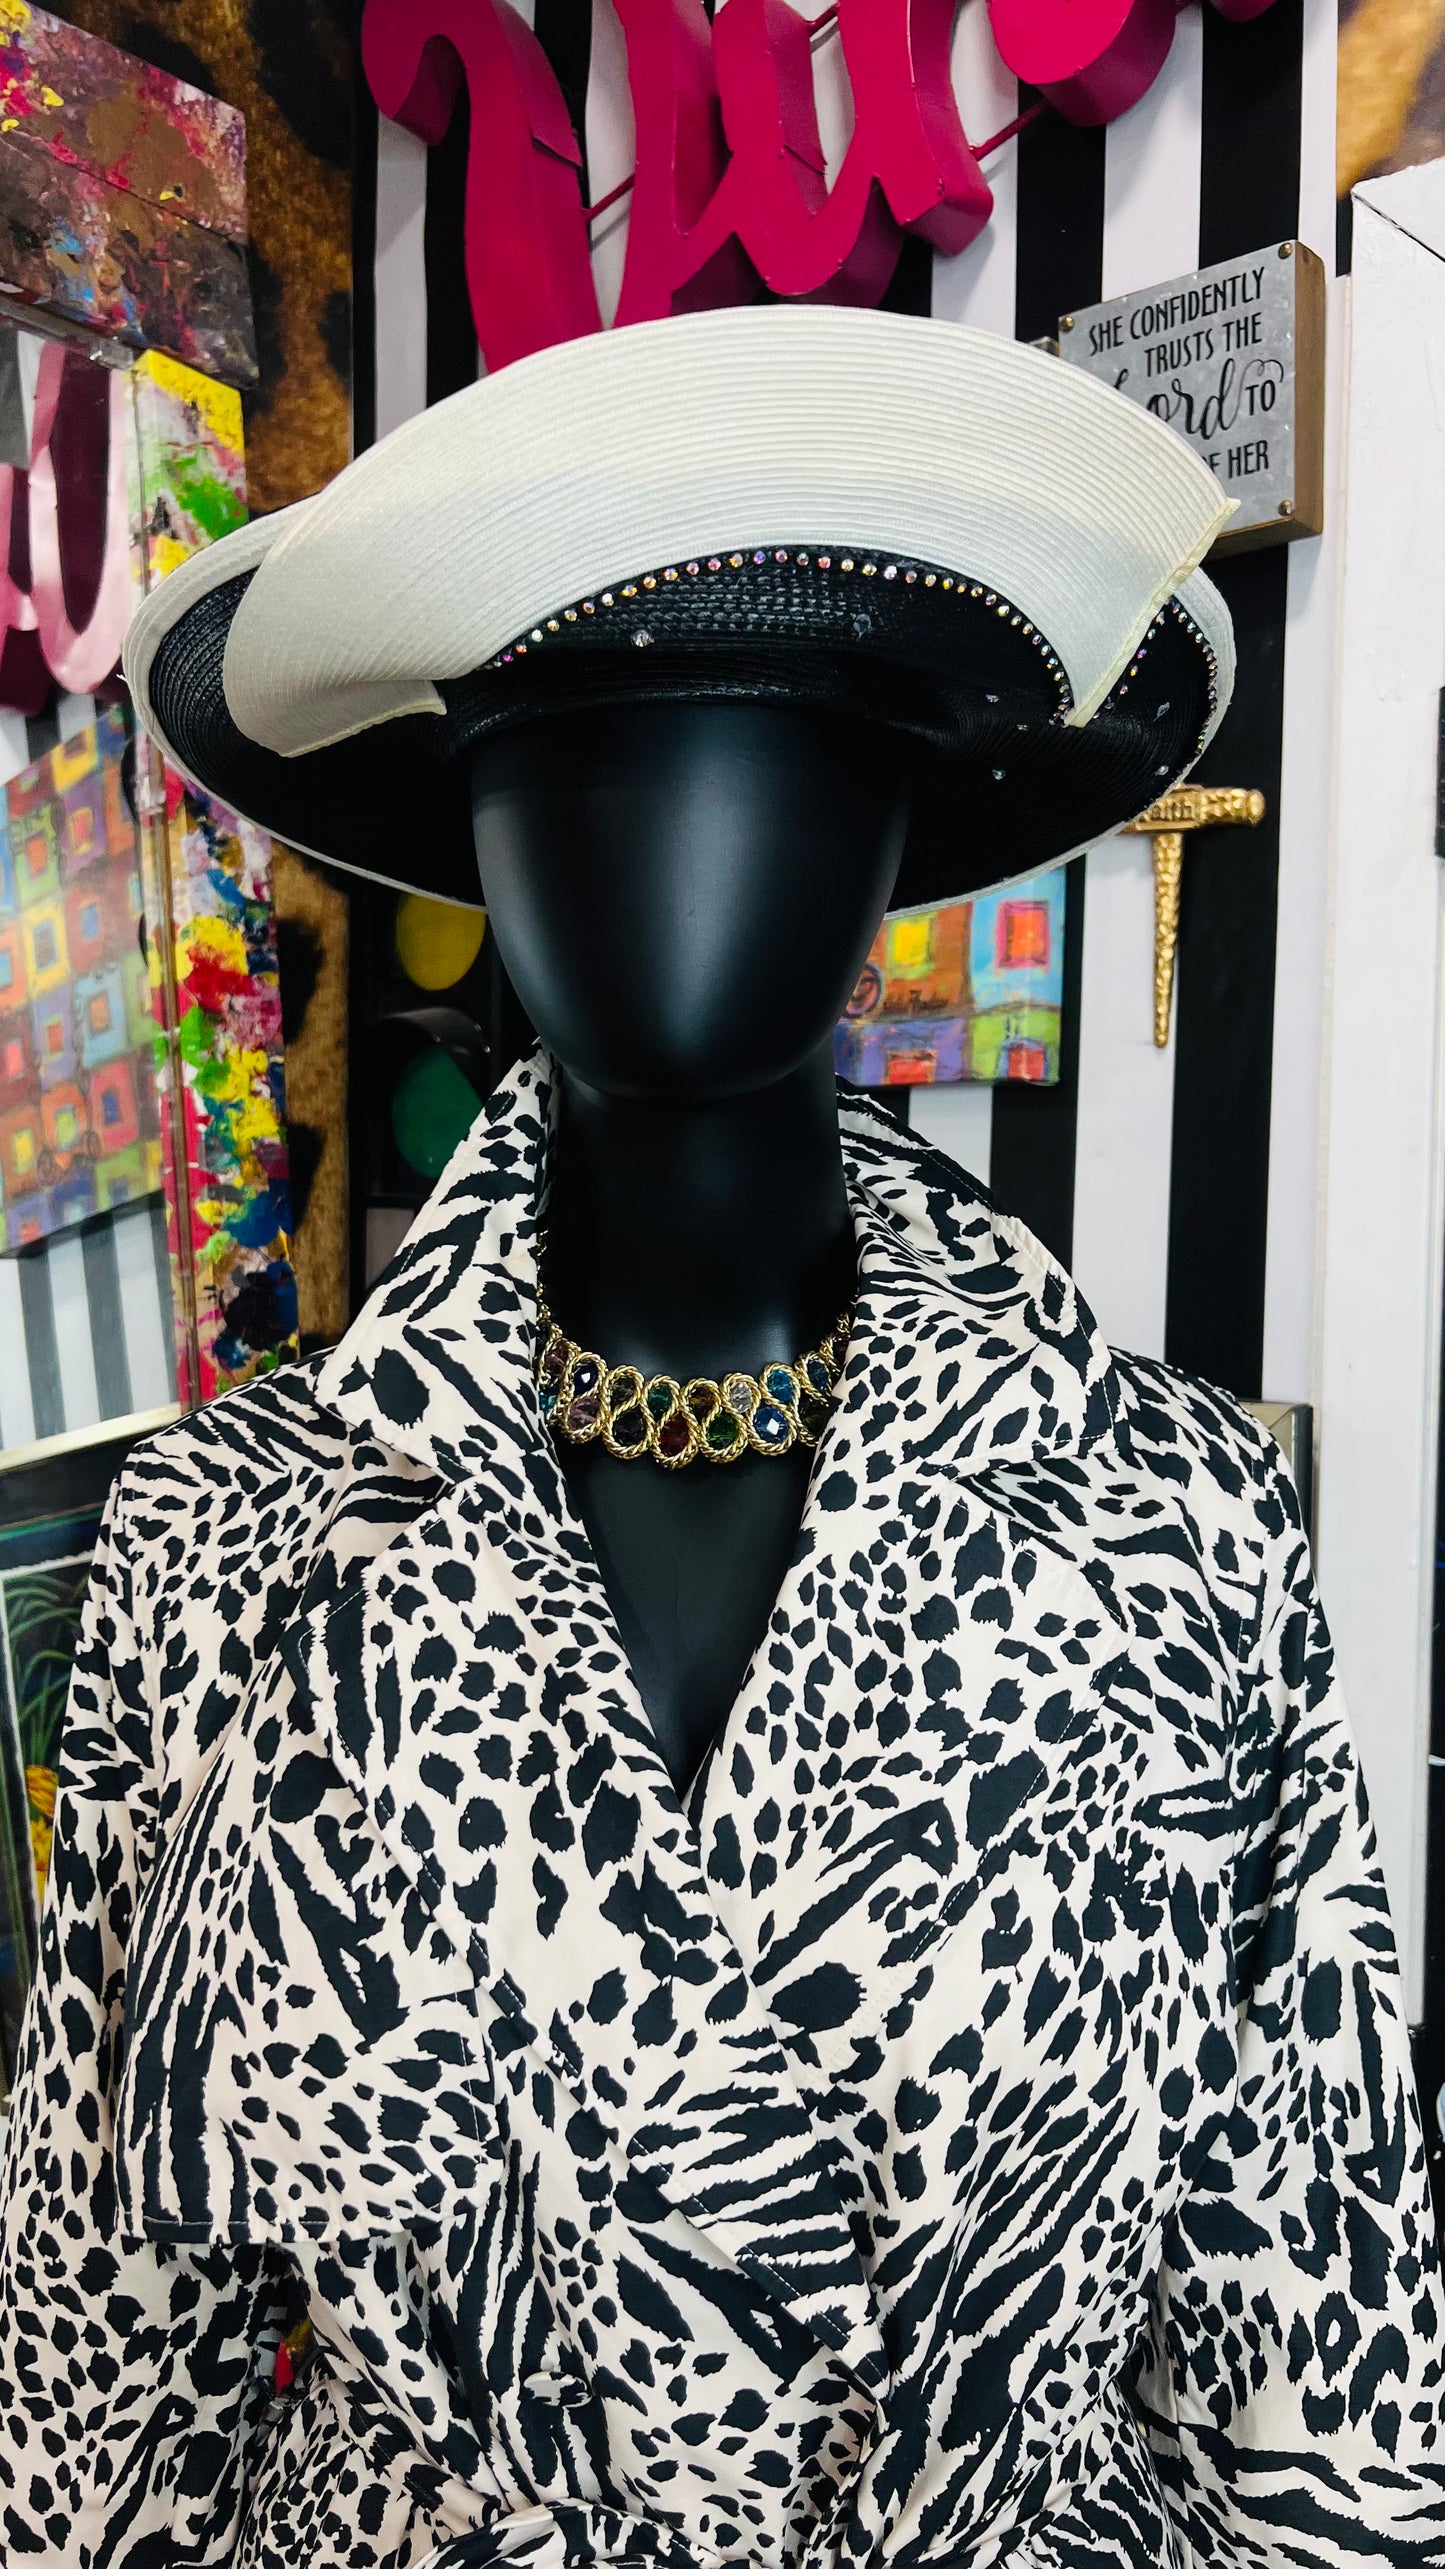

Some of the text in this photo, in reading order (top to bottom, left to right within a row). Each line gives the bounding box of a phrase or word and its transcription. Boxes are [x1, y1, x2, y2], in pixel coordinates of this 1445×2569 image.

[1088, 266, 1265, 357] SHE CONFIDENTLY
[1144, 312, 1262, 377] TRUSTS THE
[1113, 358, 1284, 440] ord TO
[1201, 440, 1269, 479] F HER
[1139, 796, 1194, 823] aith
